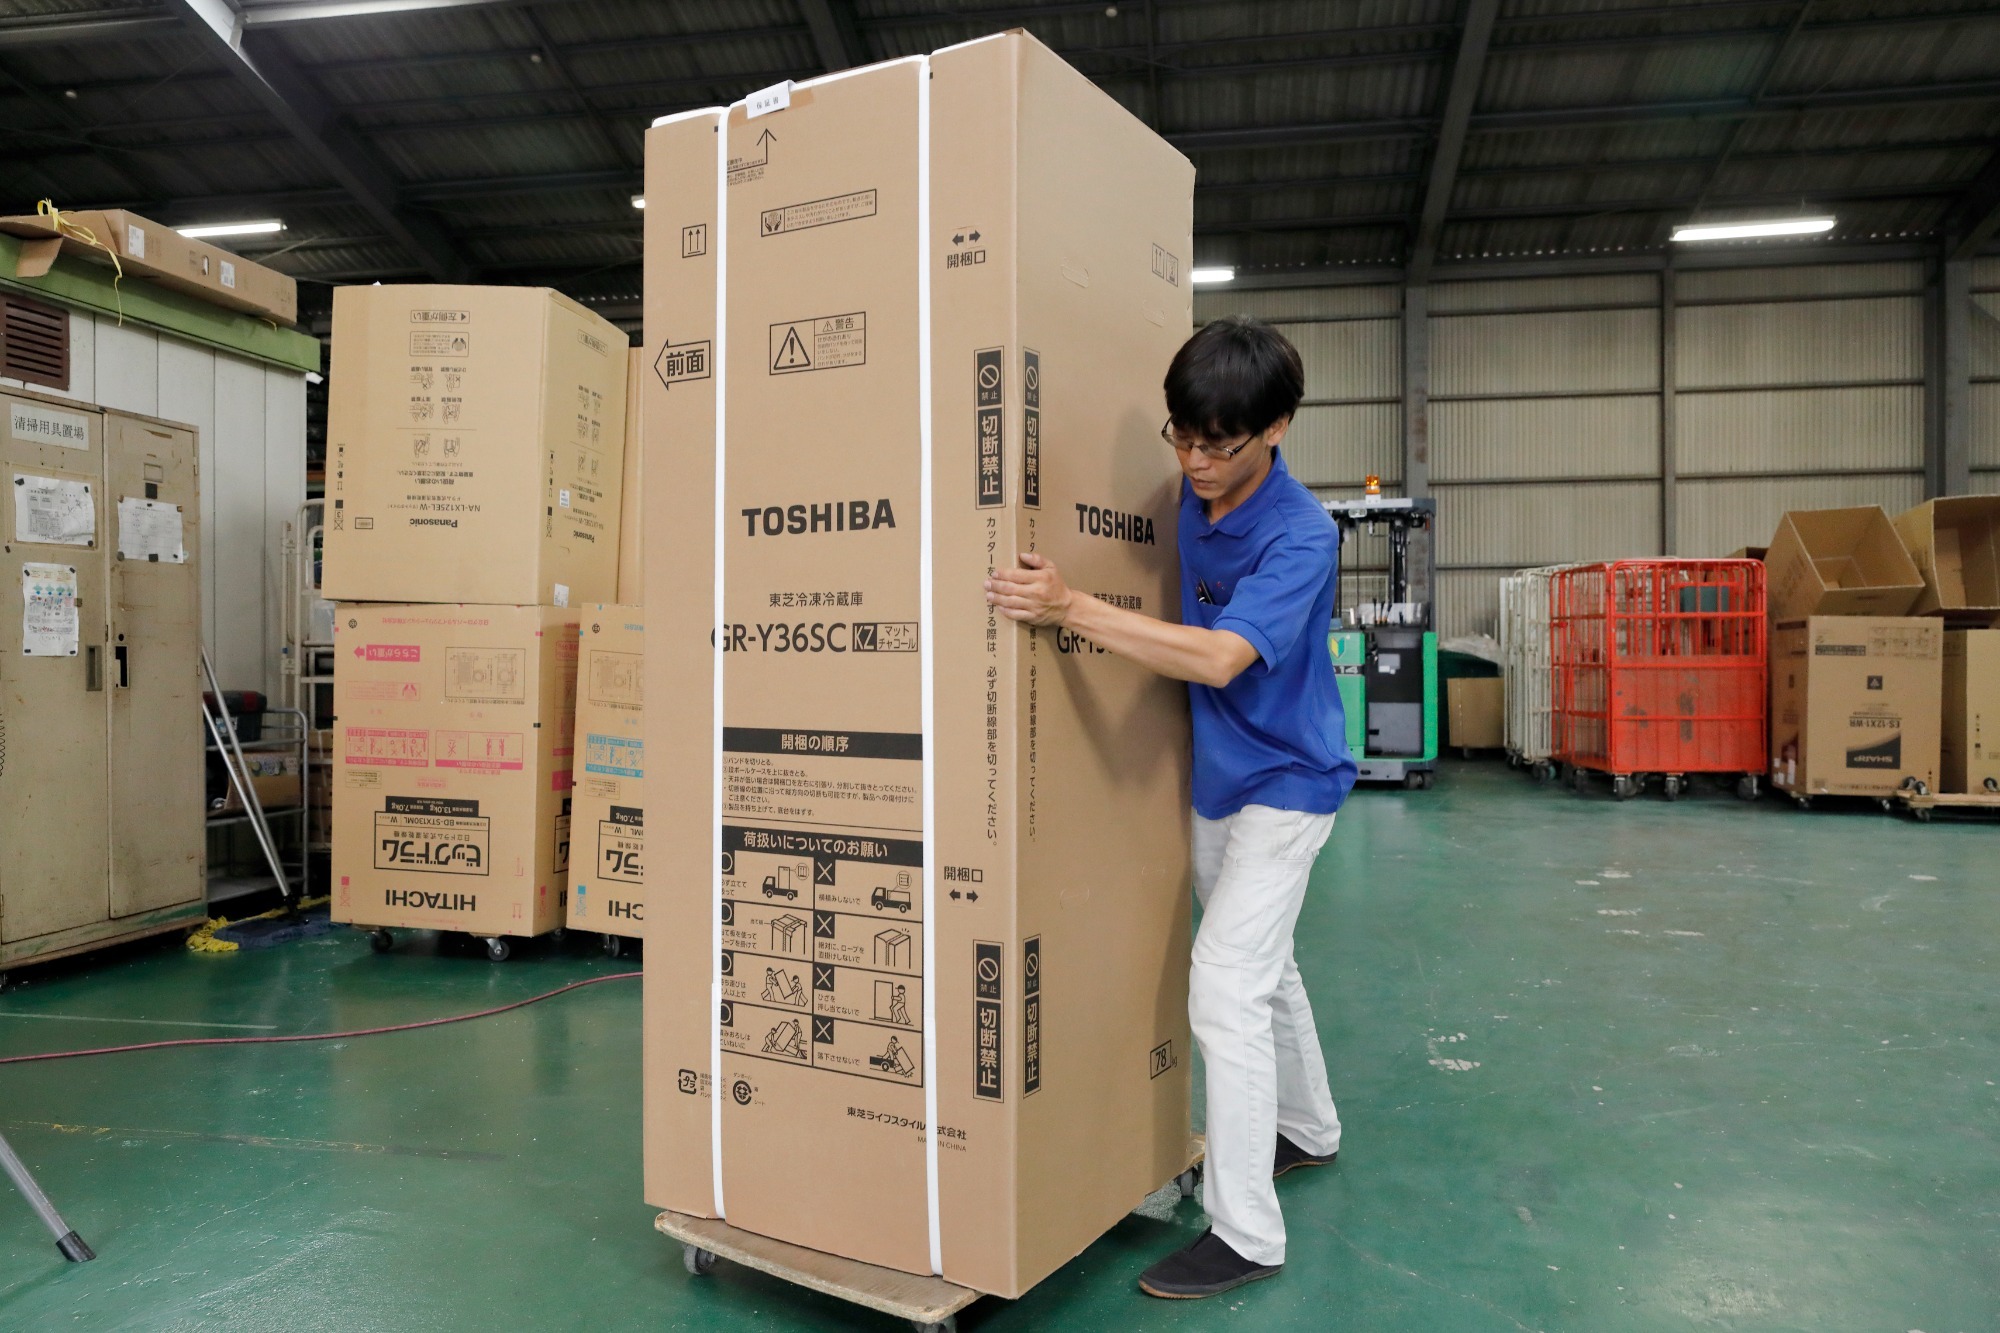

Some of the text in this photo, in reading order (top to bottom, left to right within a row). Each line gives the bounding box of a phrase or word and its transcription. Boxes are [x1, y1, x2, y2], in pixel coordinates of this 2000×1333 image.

[947, 250, 985, 269] 開梱口
[835, 317, 854, 330] 警告
[666, 349, 704, 377] 前面
[981, 391, 998, 401] 禁止
[1026, 391, 1037, 402] 禁止
[14, 415, 85, 440] 清掃用具置場
[981, 415, 999, 496] 切断禁止
[1026, 415, 1037, 497] 切断禁止
[419, 503, 481, 512] NA-LX125EL-W
[409, 518, 458, 528] Panasonic
[742, 498, 896, 536] TOSHIBA
[1075, 503, 1155, 545] TOSHIBA
[572, 530, 595, 543] Panasonic
[769, 591, 864, 607] 東芝冷凍冷蔵庫
[884, 625, 909, 636] マット
[854, 625, 874, 650] KZ
[878, 638, 916, 649] チャコール
[368, 648, 418, 659] こちらが重い
[1334, 666, 1358, 674] 14
[986, 517, 997, 847] カッターをする際は、必ず切断線部を切ってください。
[781, 733, 850, 753] 開梱の順序
[1853, 755, 1893, 763] SHARP
[728, 794, 770, 804] ご注意ください。
[391, 802, 409, 811] 7.0kg
[430, 804, 451, 814] 13.0kg
[615, 812, 635, 823] 7.0kg
[393, 831, 470, 842] 日立ドラム式洗濯乾燥機
[744, 831, 888, 858] 荷扱いについてのお願い
[382, 839, 481, 867] ビッグドラム
[944, 866, 983, 883] 開梱口
[385, 889, 476, 911] HITACHI
[818, 893, 861, 905] 横積みしないで
[818, 942, 864, 954] 絶対に、ロープを
[980, 984, 997, 994] 禁止
[1027, 980, 1037, 989] 禁止
[818, 993, 836, 1003] ひざを
[818, 1003, 860, 1016] 押し当てないで
[980, 1008, 997, 1089] 切断禁止
[1026, 1004, 1038, 1083] 切断禁止
[818, 1052, 861, 1066] 落下させないで
[1156, 1047, 1167, 1071] 78
[682, 1075, 696, 1089] プラ
[847, 1106, 967, 1141] 東芝ライフスタイル式会社
[946, 1143, 967, 1152] CHINA
